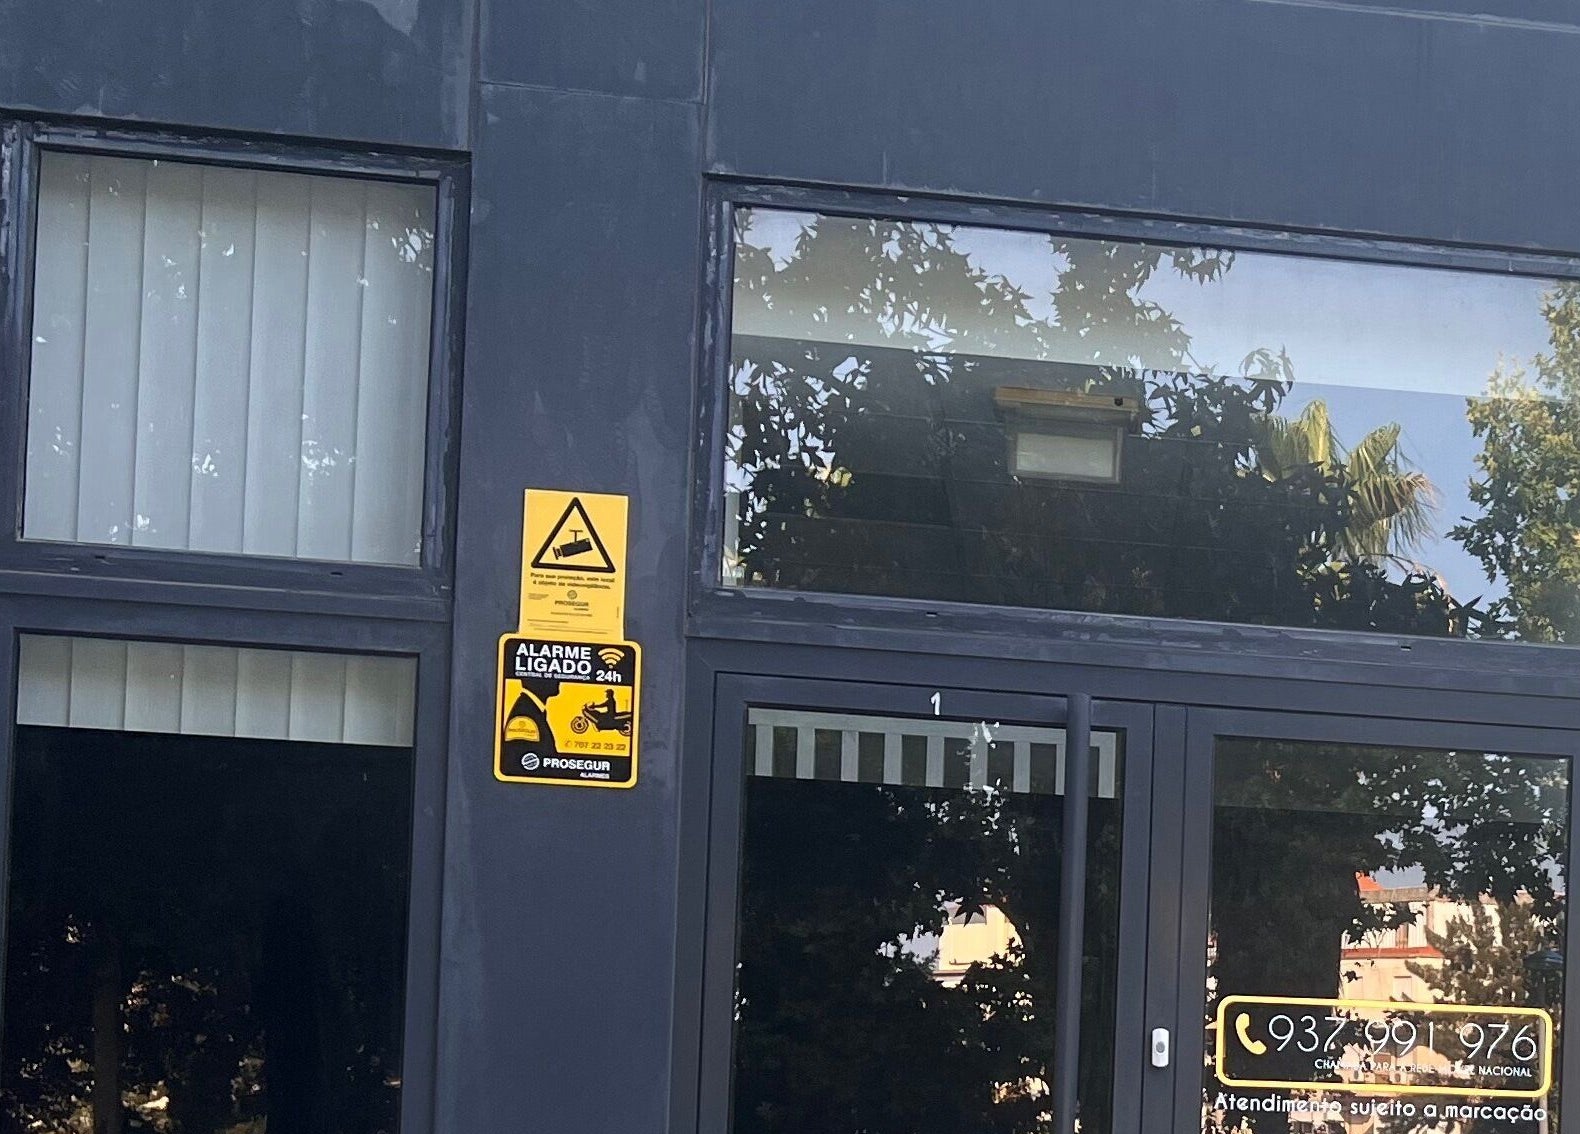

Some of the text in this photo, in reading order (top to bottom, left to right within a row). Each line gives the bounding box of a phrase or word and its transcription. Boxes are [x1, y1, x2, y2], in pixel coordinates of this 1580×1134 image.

[516, 642, 592, 660] ALARME
[515, 656, 592, 675] LIGADO
[595, 669, 622, 683] 24h
[542, 757, 611, 771] PROSEGUR
[1267, 1013, 1538, 1062] 937 991 976
[1314, 1057, 1367, 1073] CHAA
[1478, 1064, 1533, 1078] NACIONAL
[1213, 1092, 1547, 1124] Atendimento sujeito a marcação
